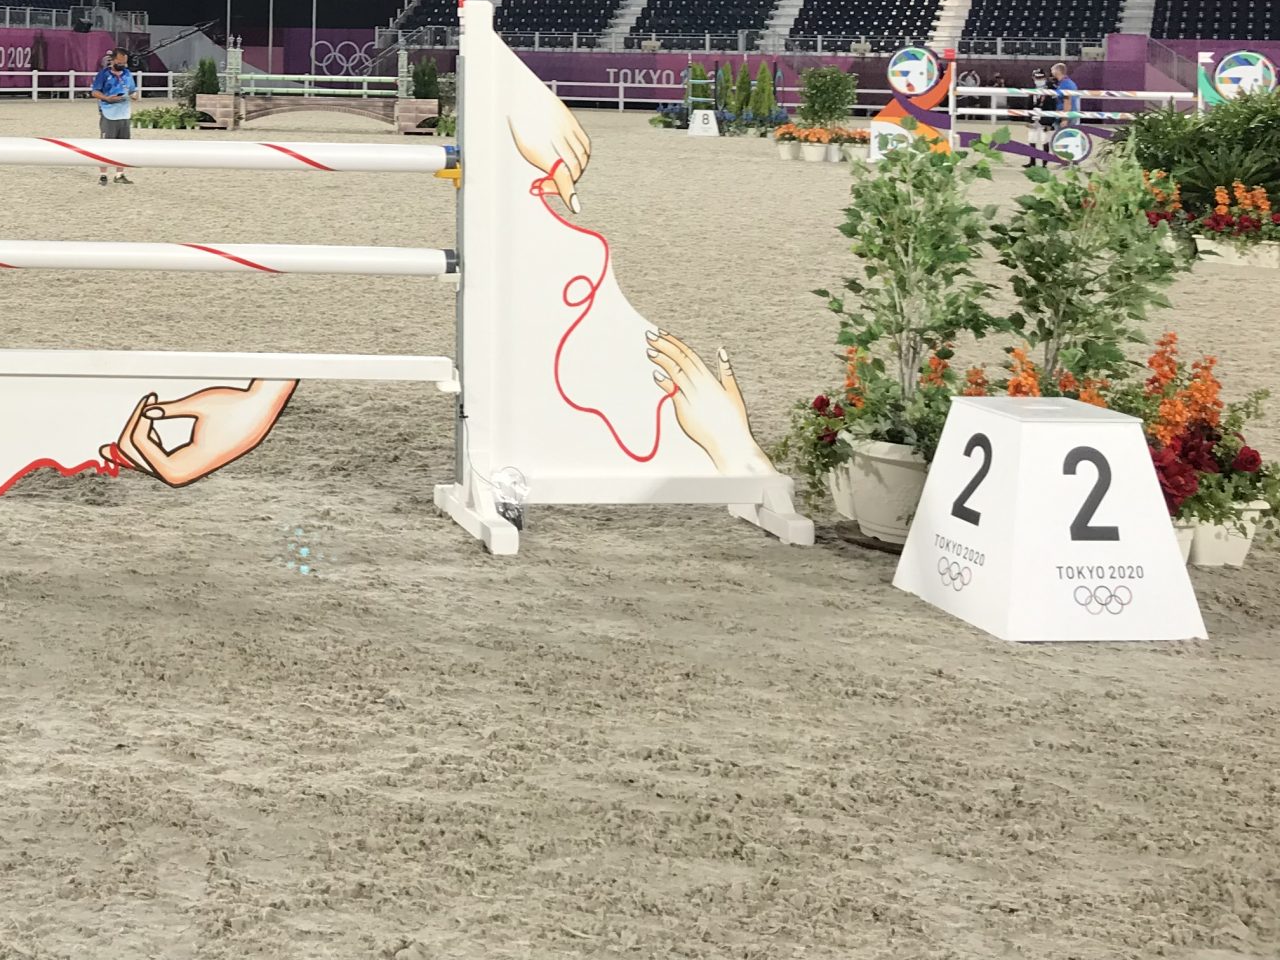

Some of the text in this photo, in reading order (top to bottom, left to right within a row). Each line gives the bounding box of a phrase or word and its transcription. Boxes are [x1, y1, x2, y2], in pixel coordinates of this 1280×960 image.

[606, 68, 675, 85] TOKYO
[702, 113, 710, 125] 8
[951, 433, 992, 526] 2
[1063, 446, 1120, 541] 2
[934, 534, 985, 567] TOKYO 2020
[1056, 565, 1144, 580] TOKYO 2020
